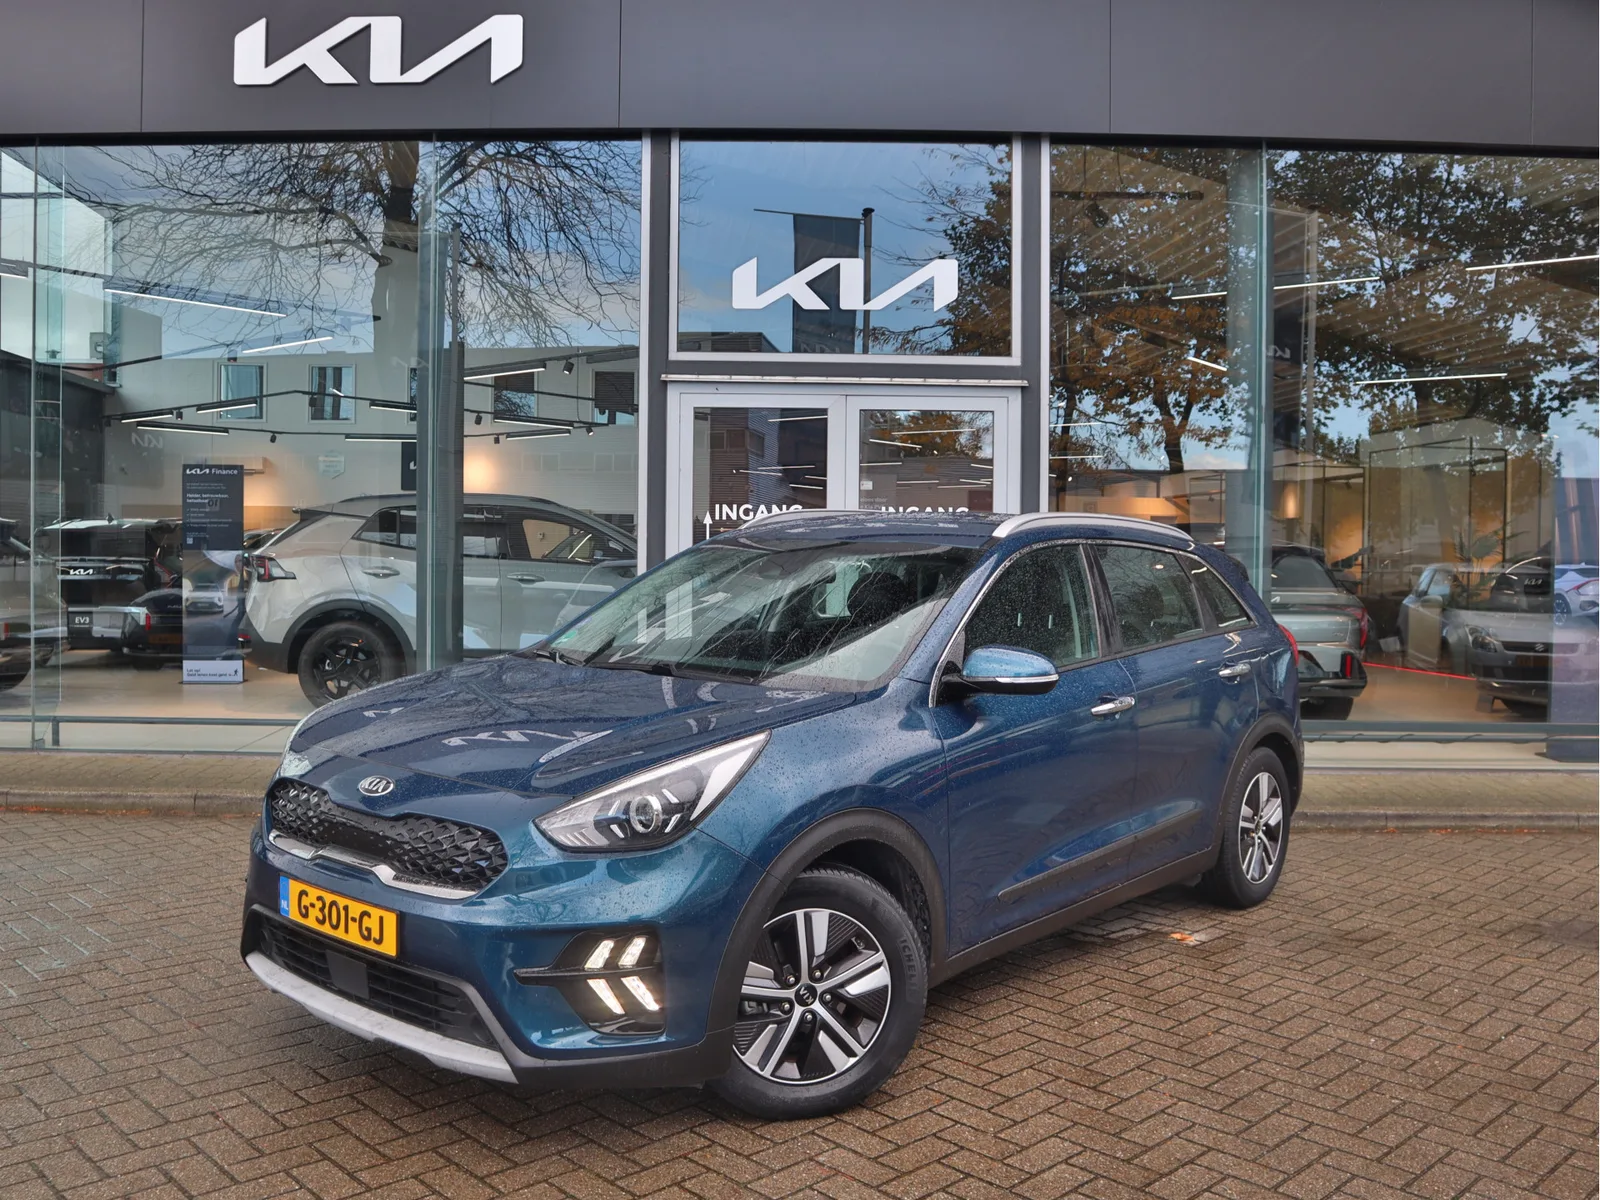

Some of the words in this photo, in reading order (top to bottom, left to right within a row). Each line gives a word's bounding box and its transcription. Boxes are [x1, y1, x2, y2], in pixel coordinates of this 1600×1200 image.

[234, 14, 523, 86] KIA
[732, 257, 959, 312] KIA
[186, 467, 210, 475] KIA
[75, 616, 90, 624] EV3
[361, 776, 388, 793] KIA
[281, 899, 289, 911] NL
[296, 888, 386, 946] G-301-GJ
[798, 986, 815, 1006] KIA
